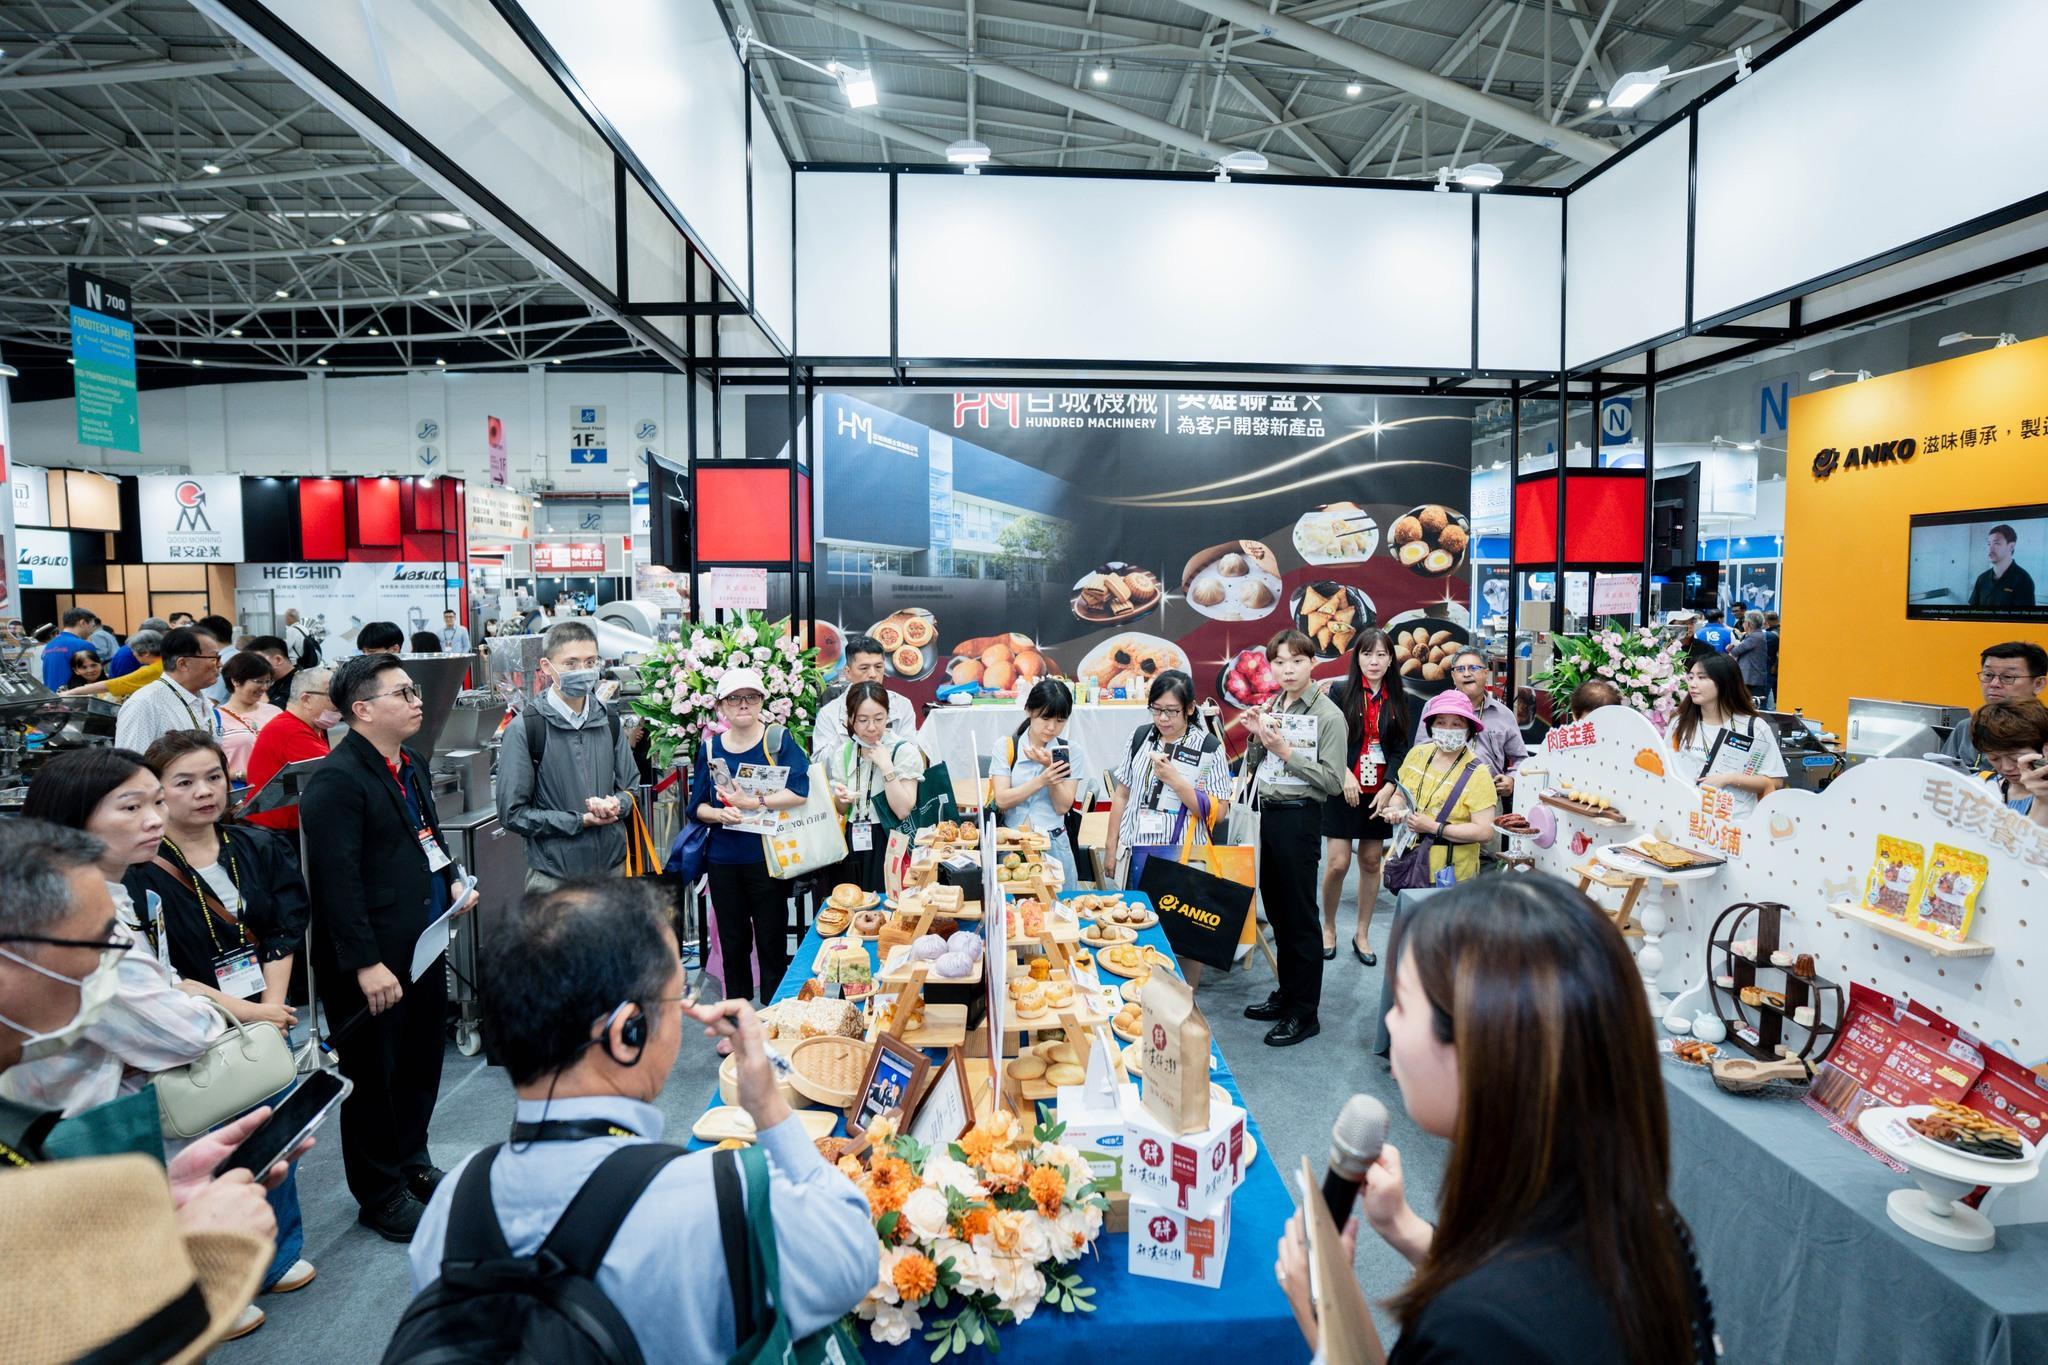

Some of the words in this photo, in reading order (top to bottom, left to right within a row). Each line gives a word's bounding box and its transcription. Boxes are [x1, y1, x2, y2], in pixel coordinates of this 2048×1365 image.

[85, 280, 102, 311] N
[105, 293, 126, 311] 700
[74, 315, 110, 336] FOODTECH
[1025, 417, 1084, 428] HUNDRED
[1087, 418, 1157, 429] MACHINERY
[1177, 415, 1325, 438] 為客戶開發新產品
[1609, 408, 1625, 432] N
[573, 433, 595, 447] 1F
[1923, 416, 2048, 455] 滋味傳承，製
[1843, 438, 1917, 468] ANKO
[189, 536, 222, 544] MORNING
[263, 566, 342, 579] HEISHIN
[1547, 721, 1596, 752] 肉食主義
[1177, 903, 1221, 927] ANKO
